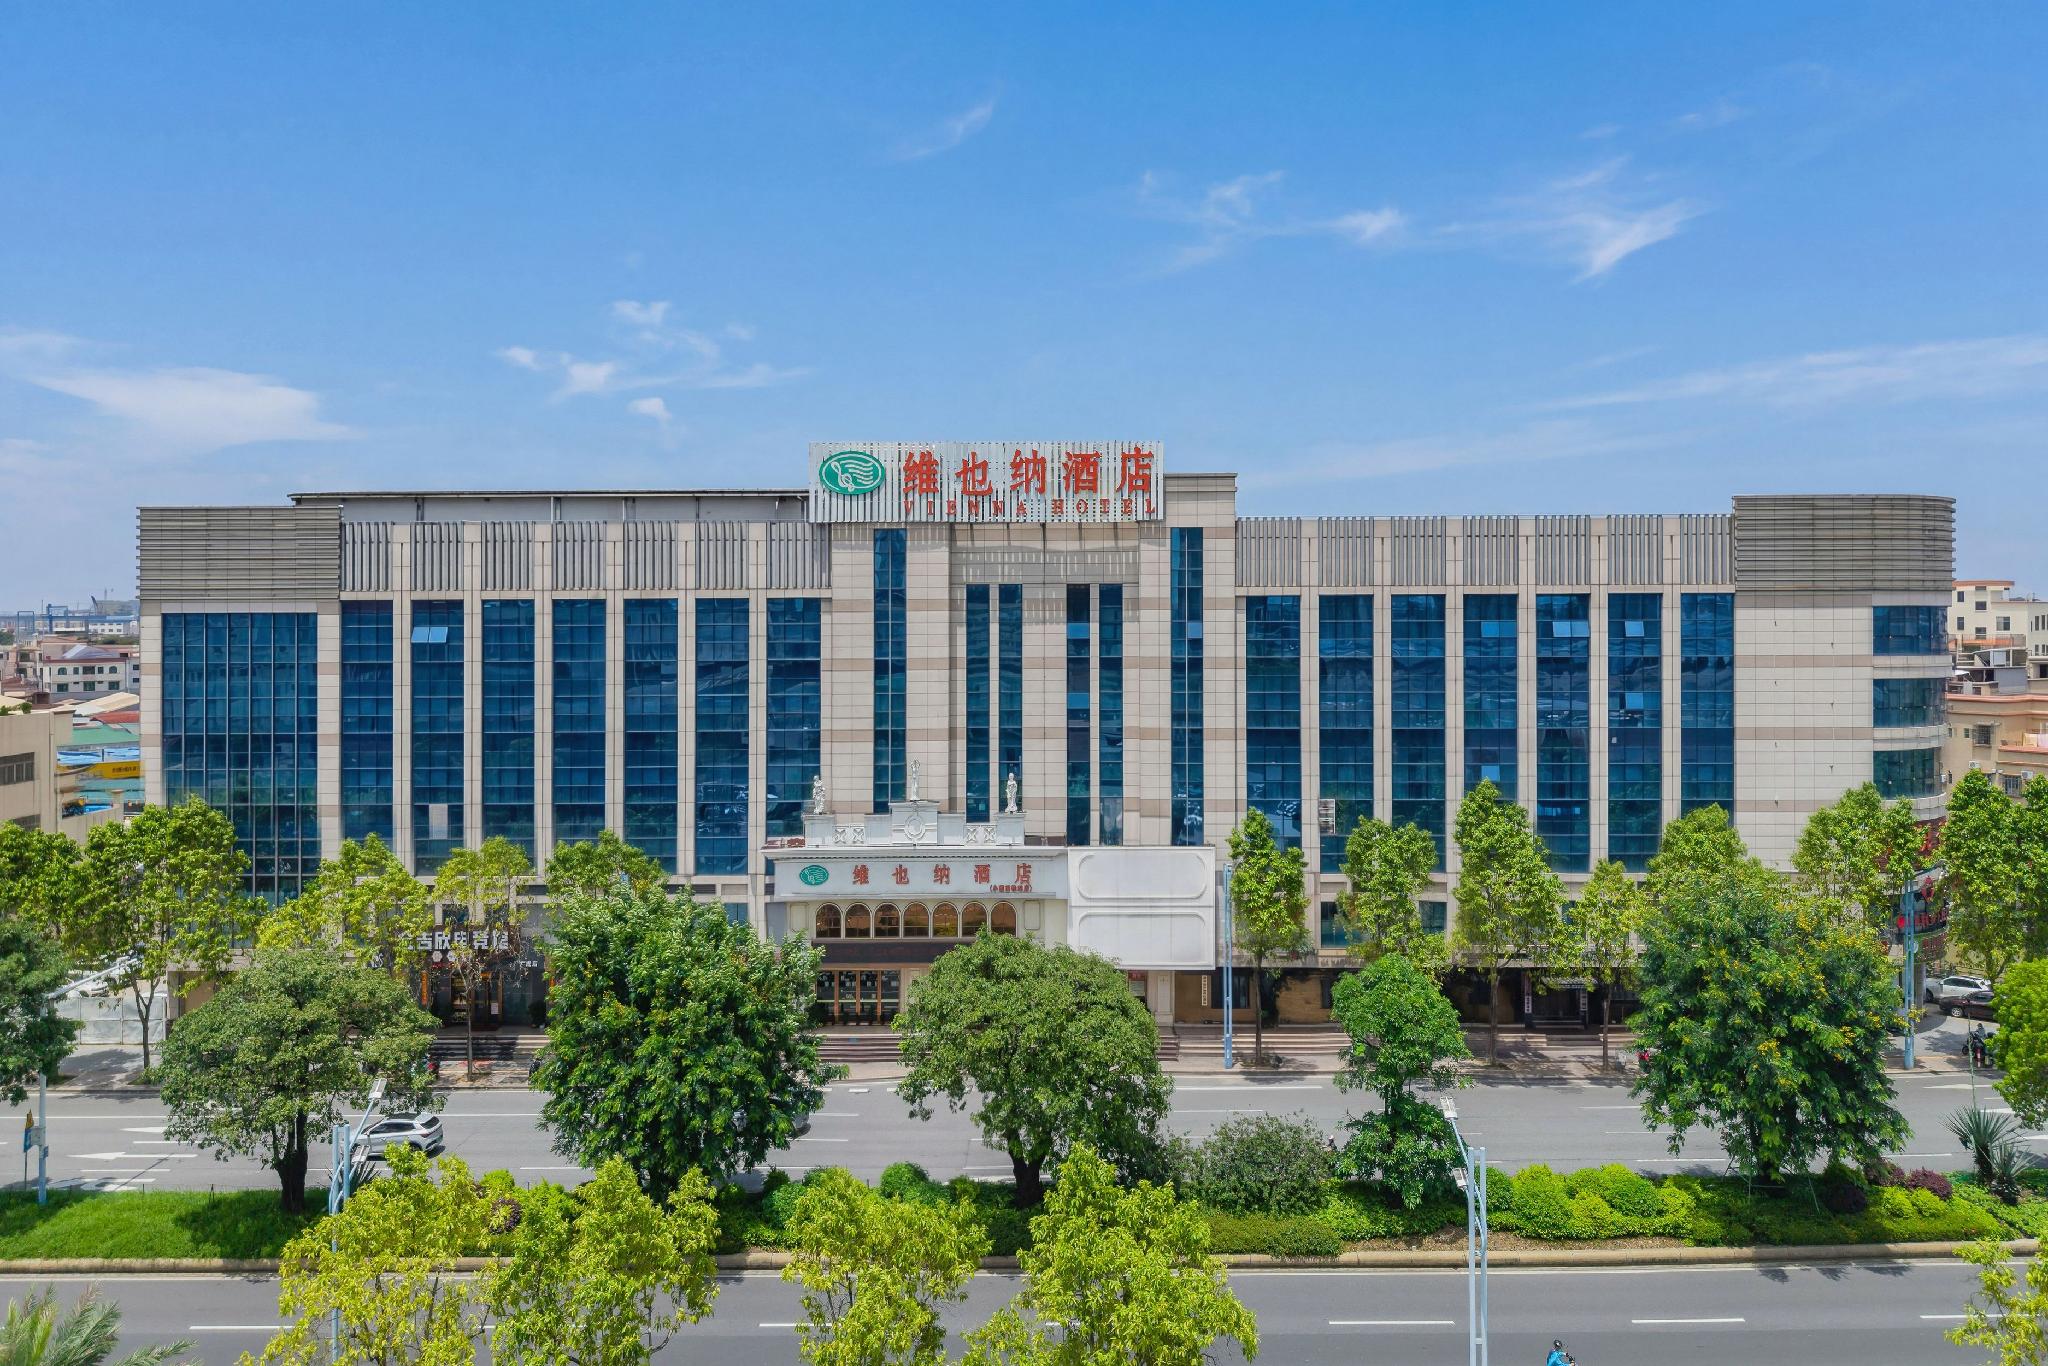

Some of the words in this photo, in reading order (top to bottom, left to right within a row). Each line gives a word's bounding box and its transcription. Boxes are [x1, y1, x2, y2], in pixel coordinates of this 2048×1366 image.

[903, 447, 1154, 496] 维也纳酒店
[904, 499, 1027, 516] VIENNA
[1052, 498, 1156, 514] HOTEL
[852, 863, 1032, 885] 维也纳酒店
